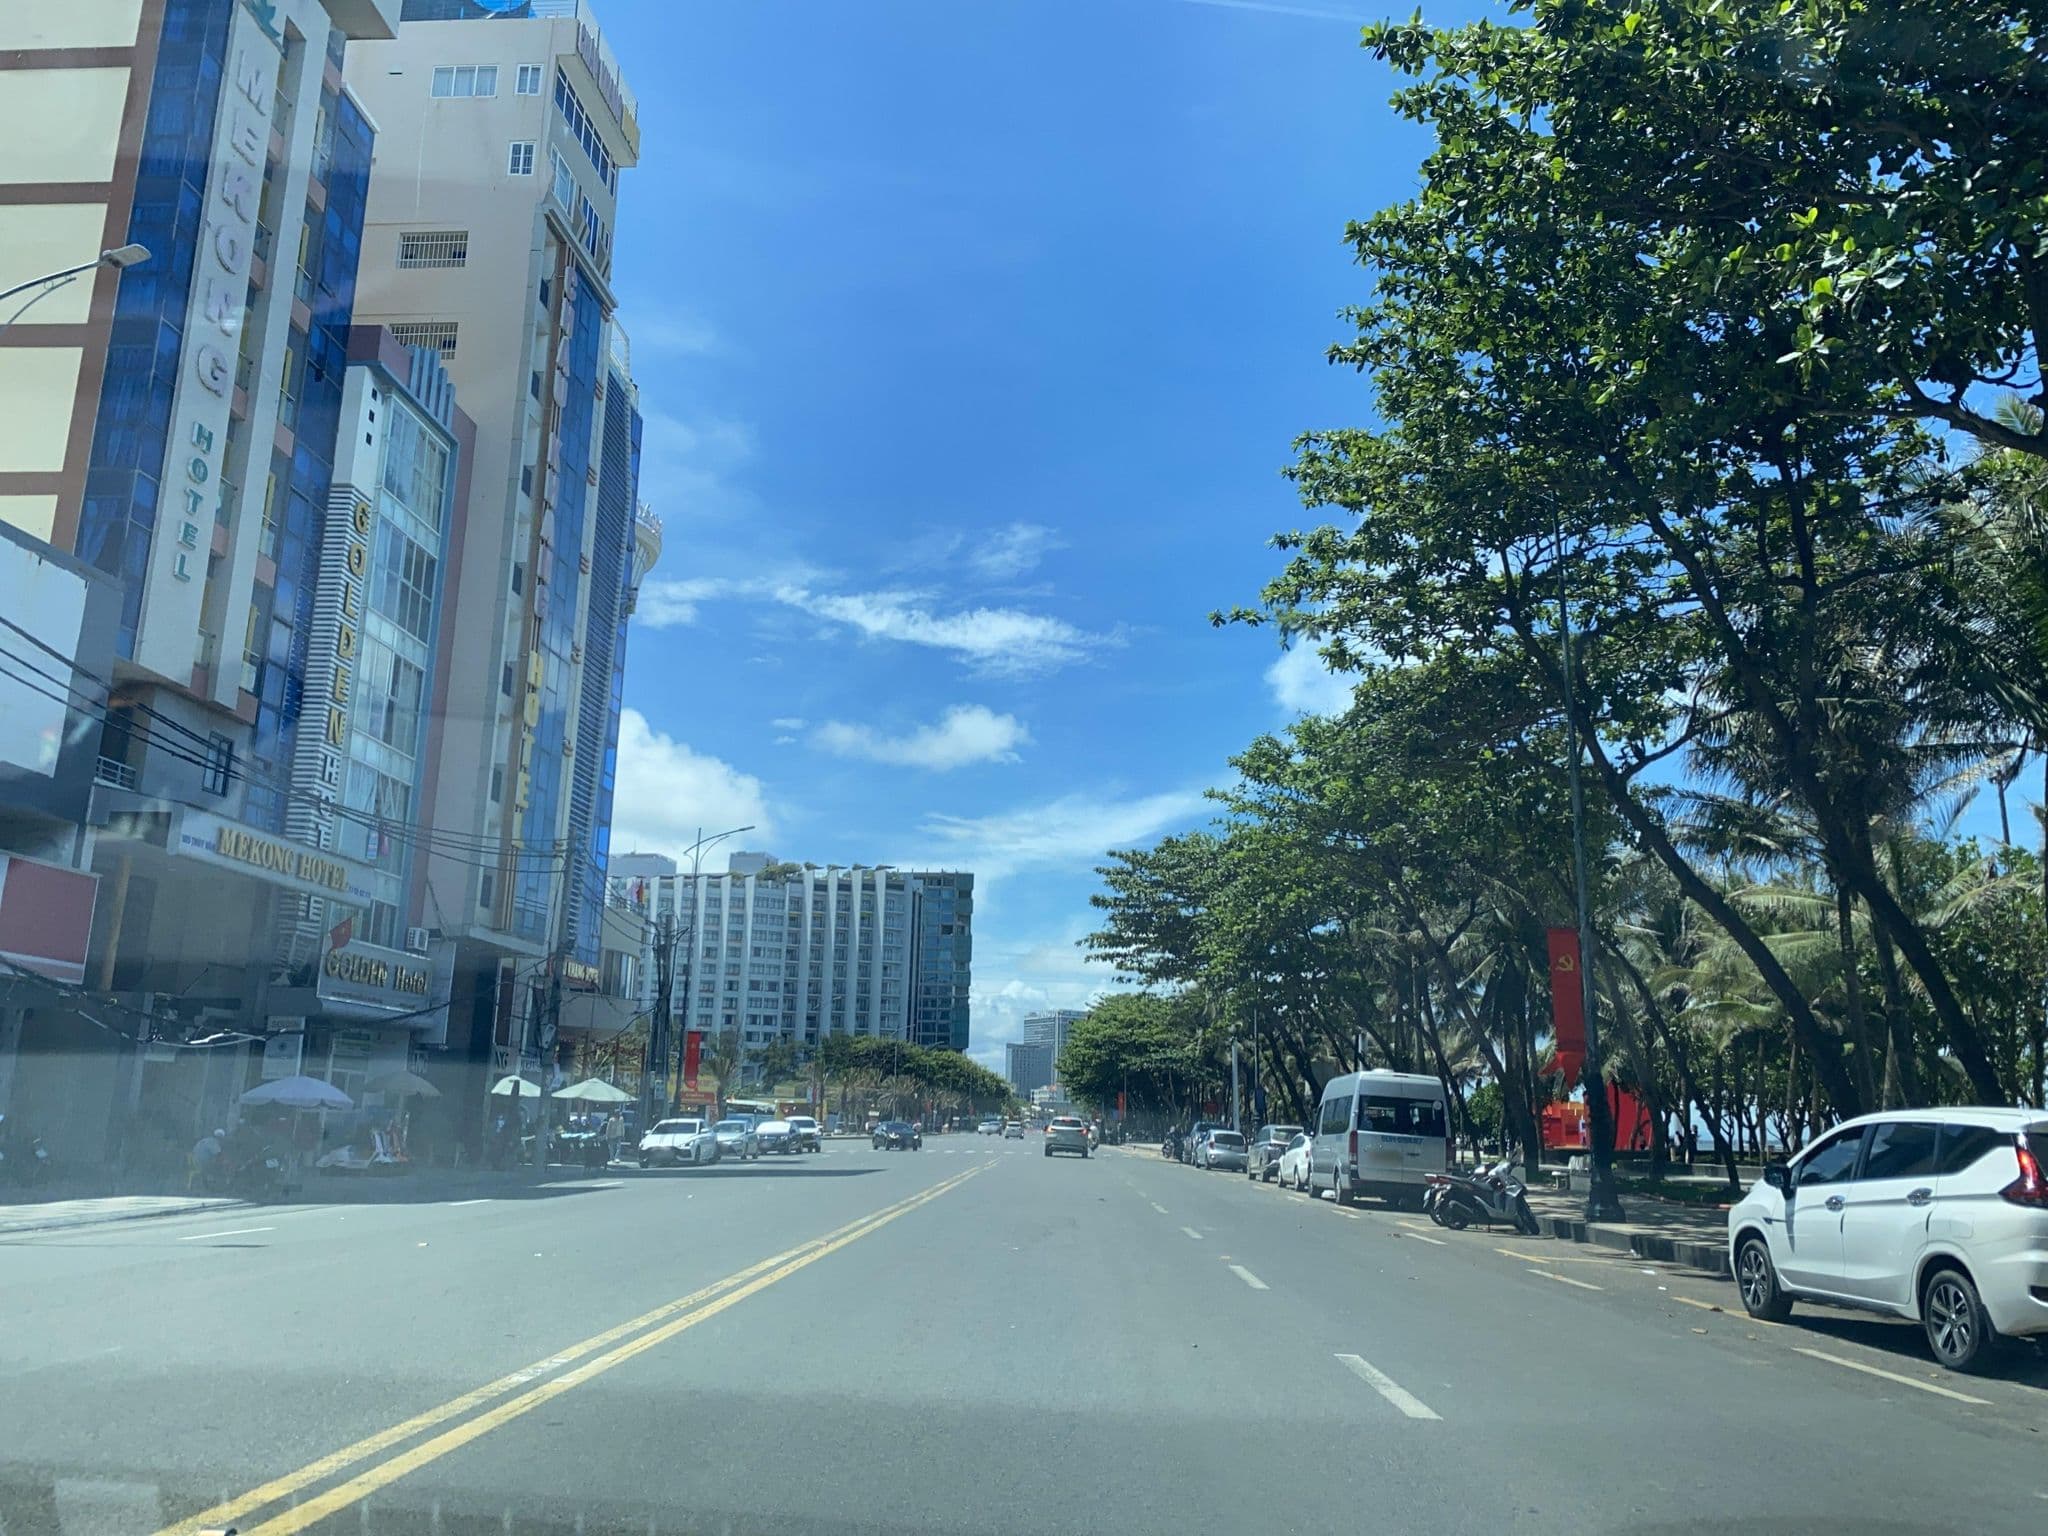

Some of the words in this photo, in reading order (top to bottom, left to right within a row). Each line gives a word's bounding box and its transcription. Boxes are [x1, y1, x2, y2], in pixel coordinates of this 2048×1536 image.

[197, 47, 267, 398] MEKONG
[174, 420, 213, 584] HOTEL
[327, 500, 370, 745] GOLDEN
[511, 650, 544, 849] HOTEL
[218, 827, 294, 874] MEKONG
[298, 853, 349, 892] HOTEL
[325, 950, 388, 987] GOLDEN
[393, 964, 428, 994] Hotel
